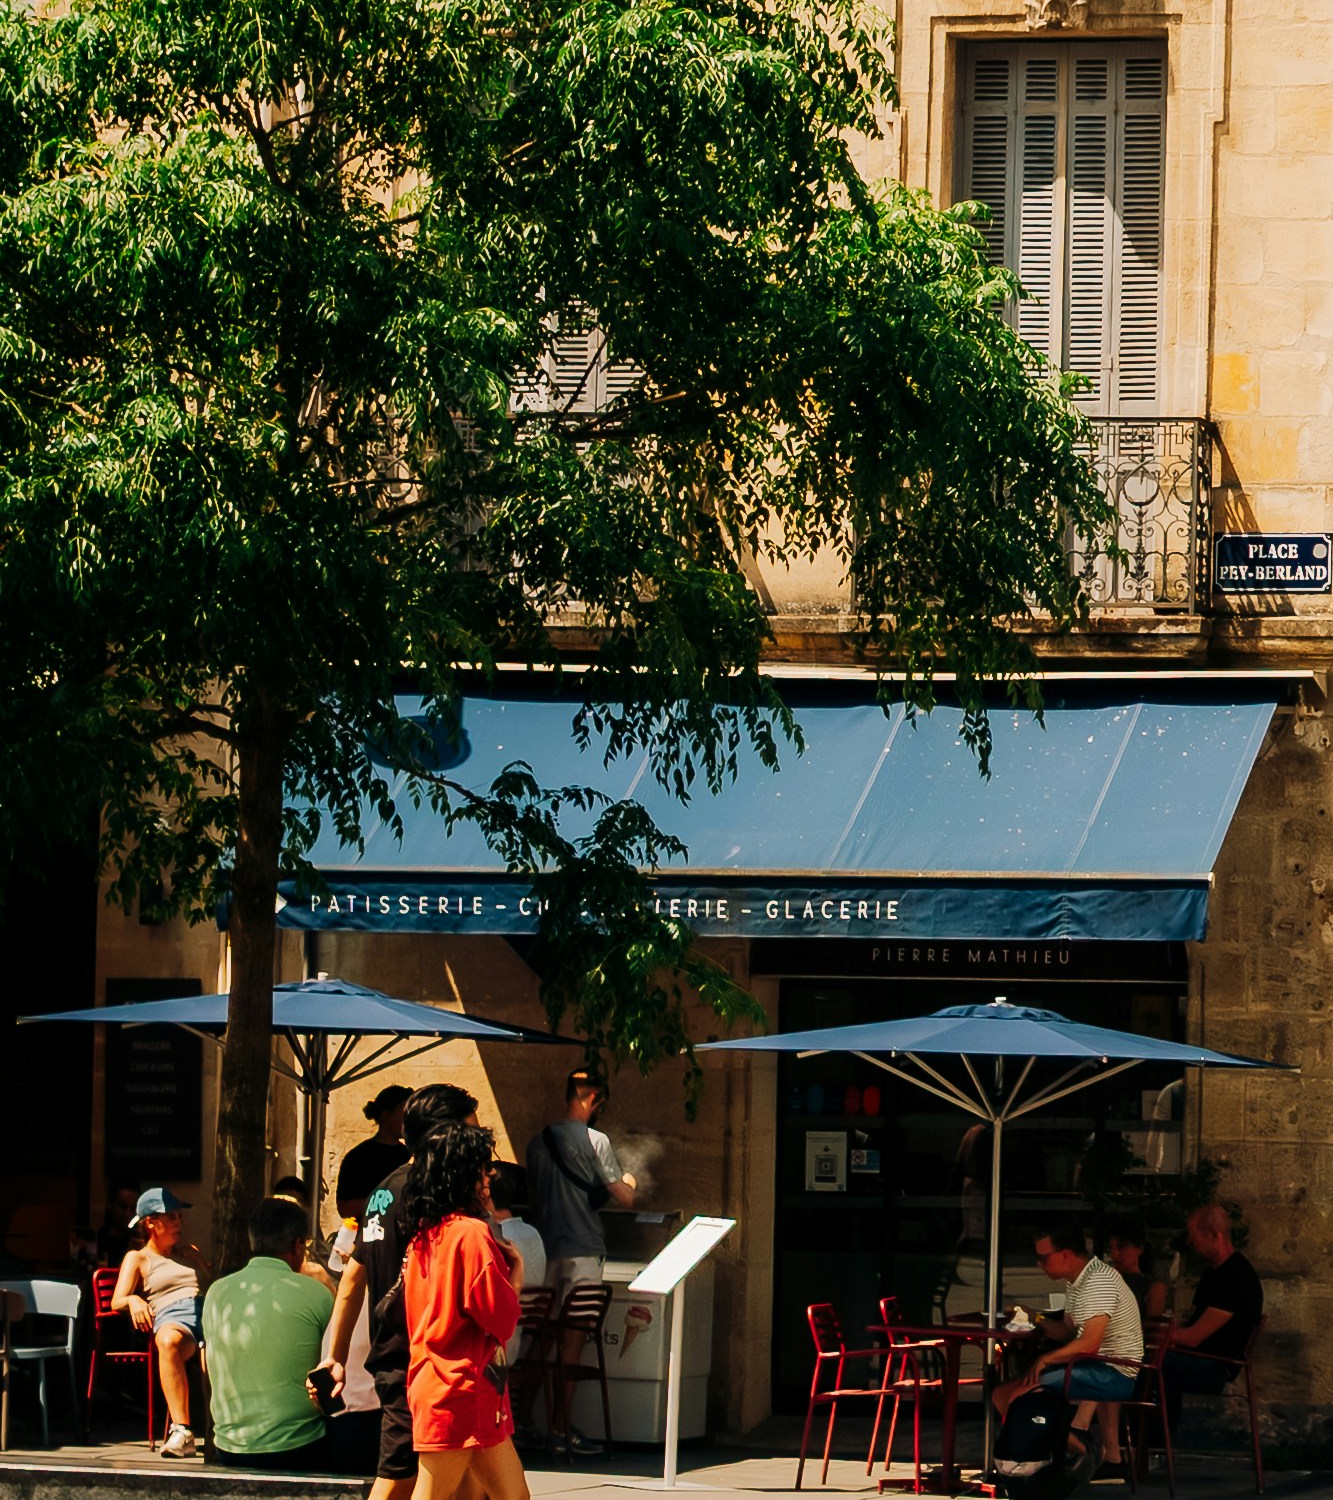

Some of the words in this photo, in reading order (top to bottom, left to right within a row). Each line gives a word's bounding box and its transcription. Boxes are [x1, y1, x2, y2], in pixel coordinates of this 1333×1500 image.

[1248, 543, 1299, 559] PLACE
[1219, 565, 1328, 581] PEY-BERLAND
[310, 894, 483, 915] PATISSERIE
[766, 900, 899, 920] GLACERIE
[872, 947, 950, 962] PIERRE
[968, 950, 1069, 964] MATHIEU
